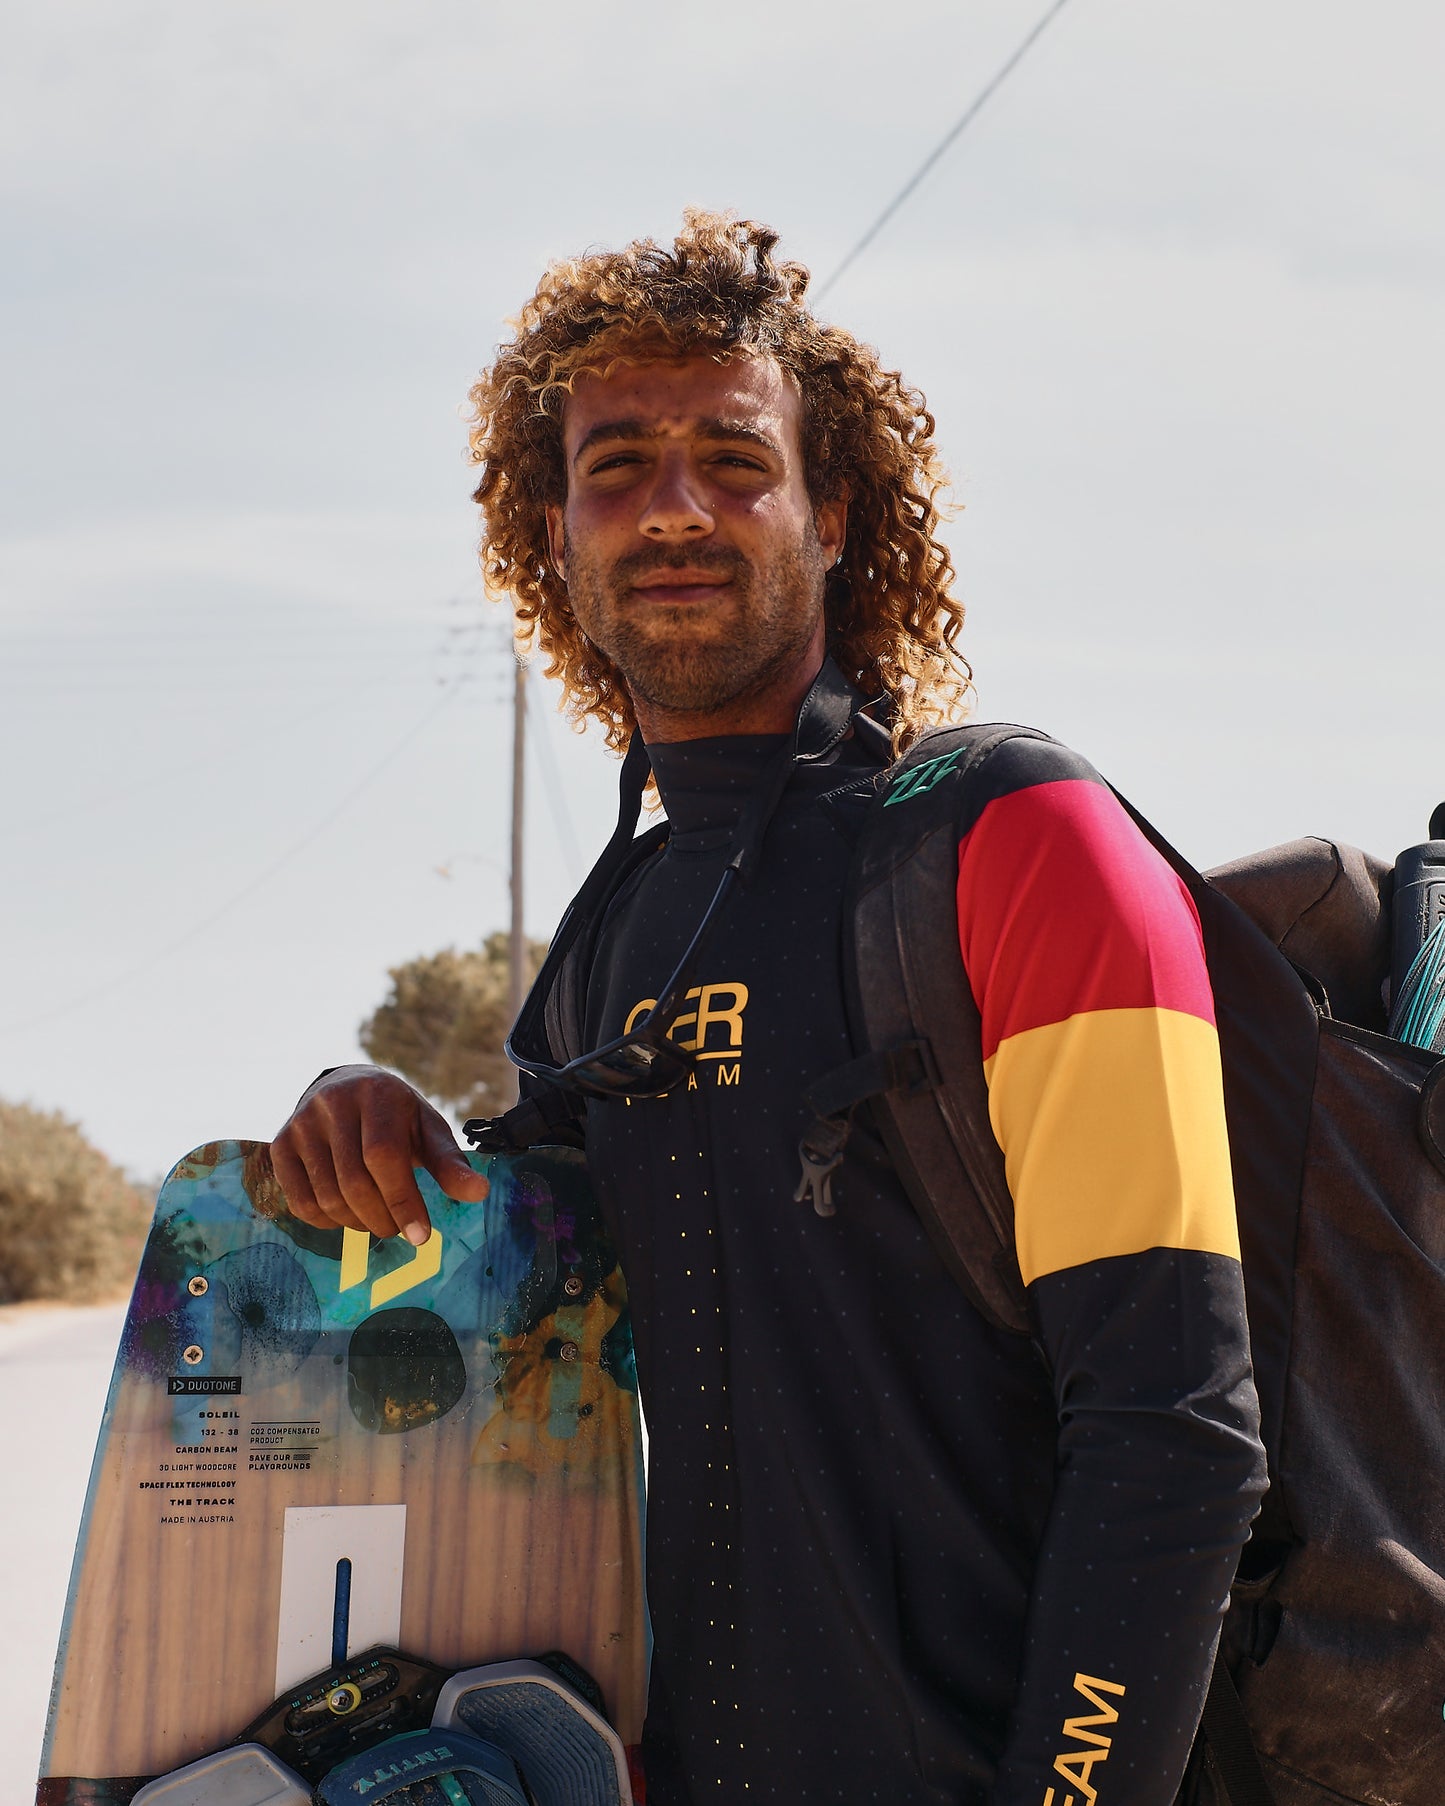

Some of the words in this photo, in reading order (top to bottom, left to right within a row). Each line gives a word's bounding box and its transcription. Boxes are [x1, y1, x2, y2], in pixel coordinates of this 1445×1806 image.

[187, 1380, 237, 1391] DUOTONE
[198, 1411, 240, 1419] SOLEIL
[200, 1428, 216, 1436] 132
[227, 1428, 239, 1436] 38
[266, 1427, 320, 1435] COMPENSATED
[250, 1436, 284, 1444] PRODUCT
[175, 1446, 211, 1454] CARBON
[195, 1463, 237, 1471] WOODCORE
[166, 1481, 185, 1489] FLEX
[198, 1515, 234, 1523] AUSTRIA
[352, 1746, 454, 1795] ENTITY
